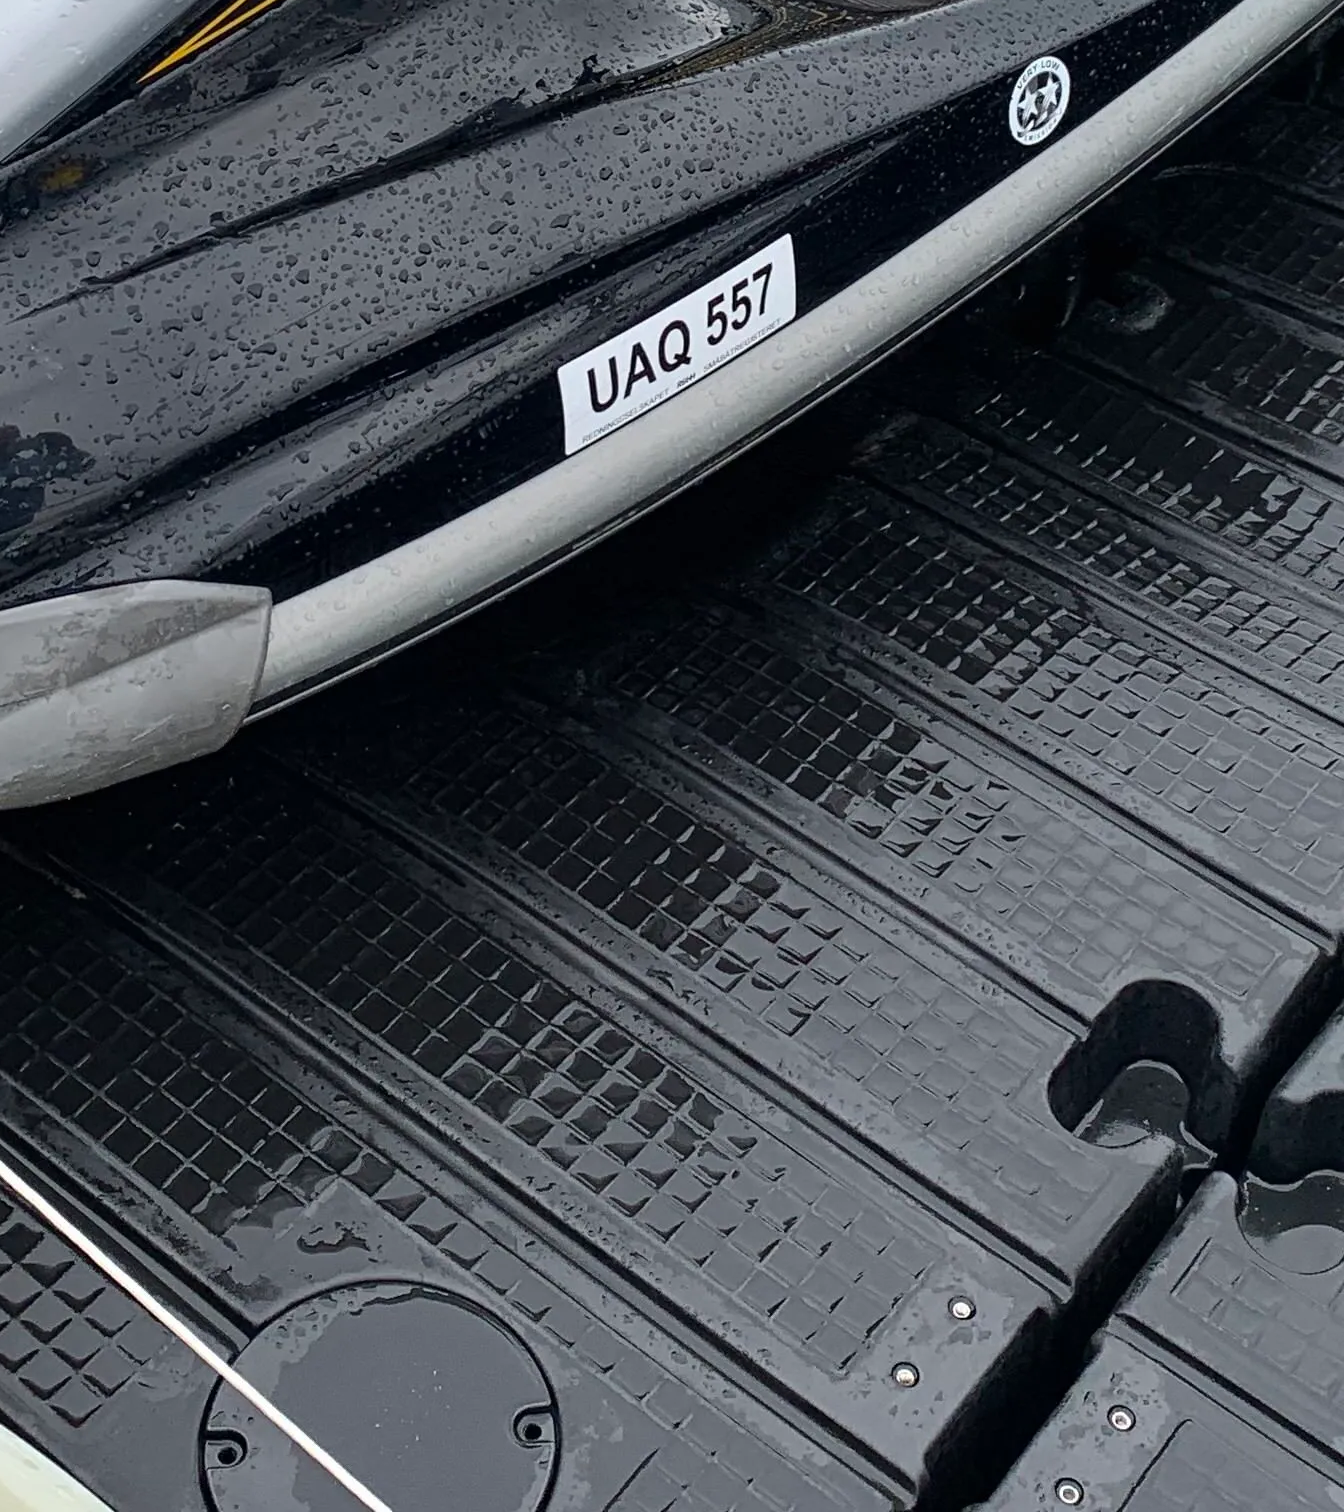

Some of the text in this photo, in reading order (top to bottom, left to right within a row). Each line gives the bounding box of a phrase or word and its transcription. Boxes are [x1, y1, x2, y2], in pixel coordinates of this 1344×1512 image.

[1041, 59, 1061, 71] LOW
[587, 262, 773, 414] UAQ 557
